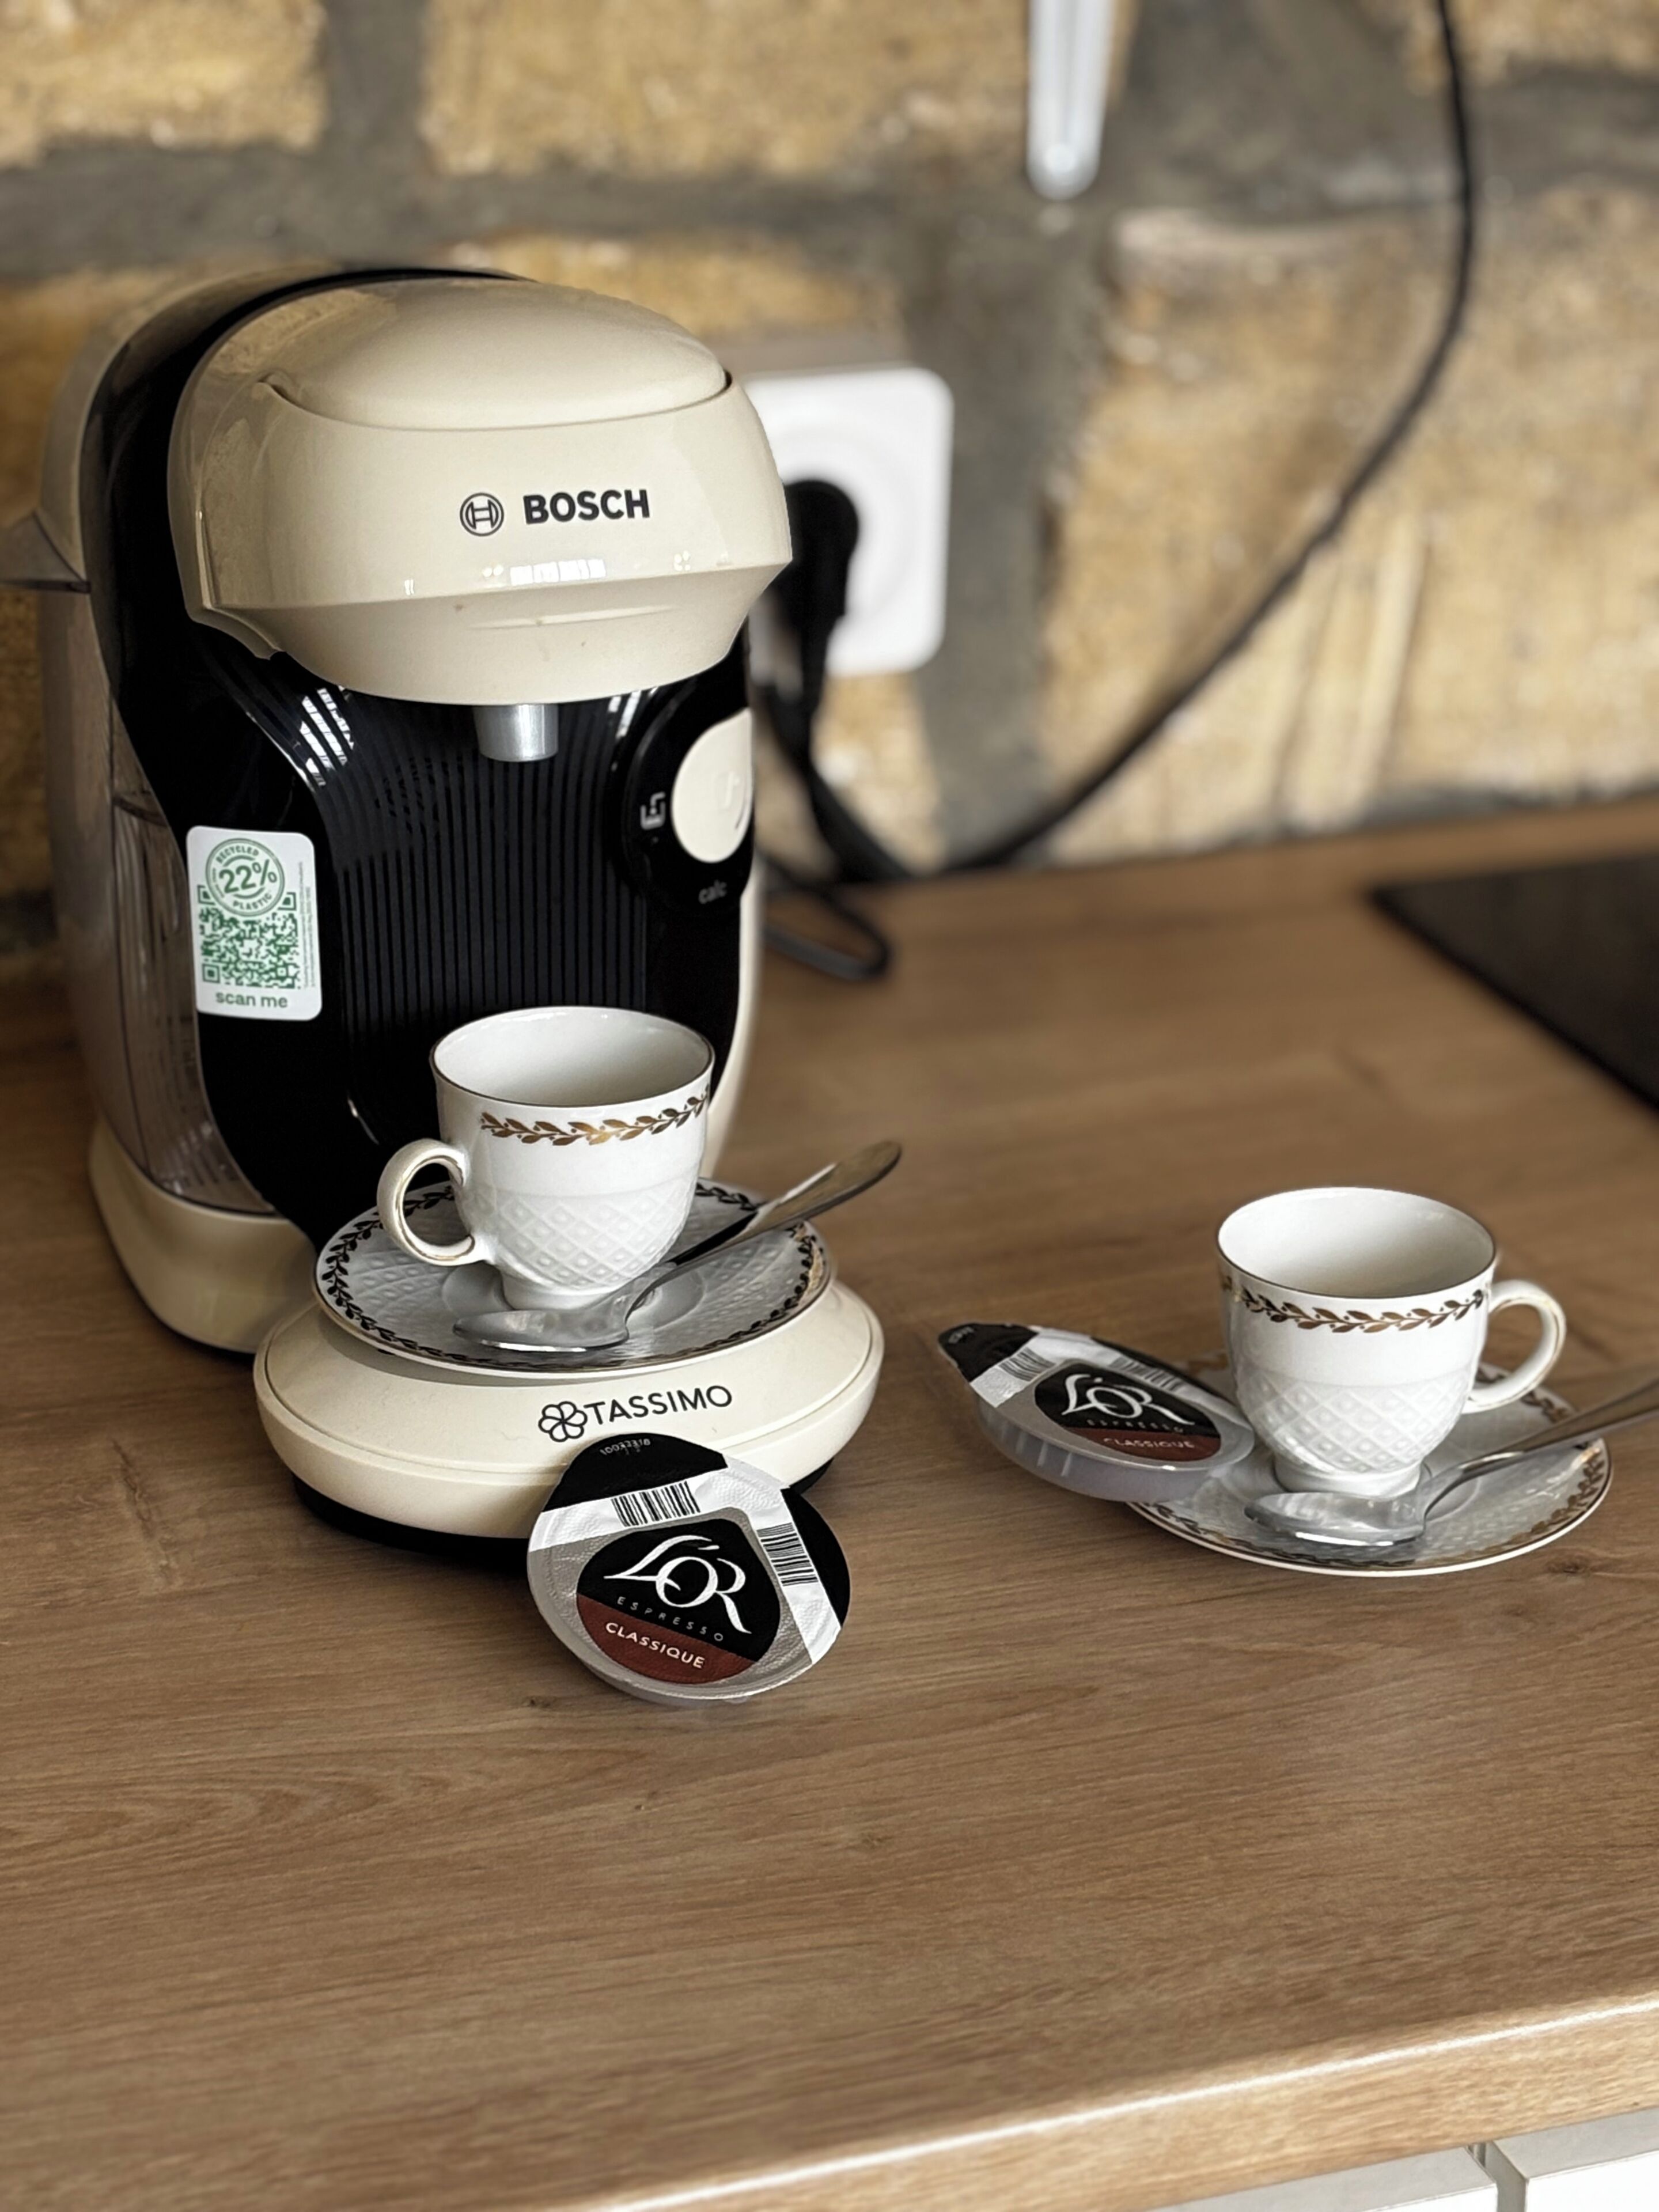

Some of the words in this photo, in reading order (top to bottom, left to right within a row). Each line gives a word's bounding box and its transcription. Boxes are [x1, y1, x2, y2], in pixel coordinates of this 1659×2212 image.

[523, 489, 650, 525] BOSCH
[215, 845, 259, 863] RECYCLED
[219, 859, 278, 893] 22%
[233, 892, 272, 910] PLASTIC
[215, 991, 256, 1006] scan
[261, 995, 288, 1008] me
[583, 1385, 733, 1425] TASSIMO
[616, 1596, 724, 1642] ESPRESSO
[605, 1622, 706, 1669] CLASSIQUE
